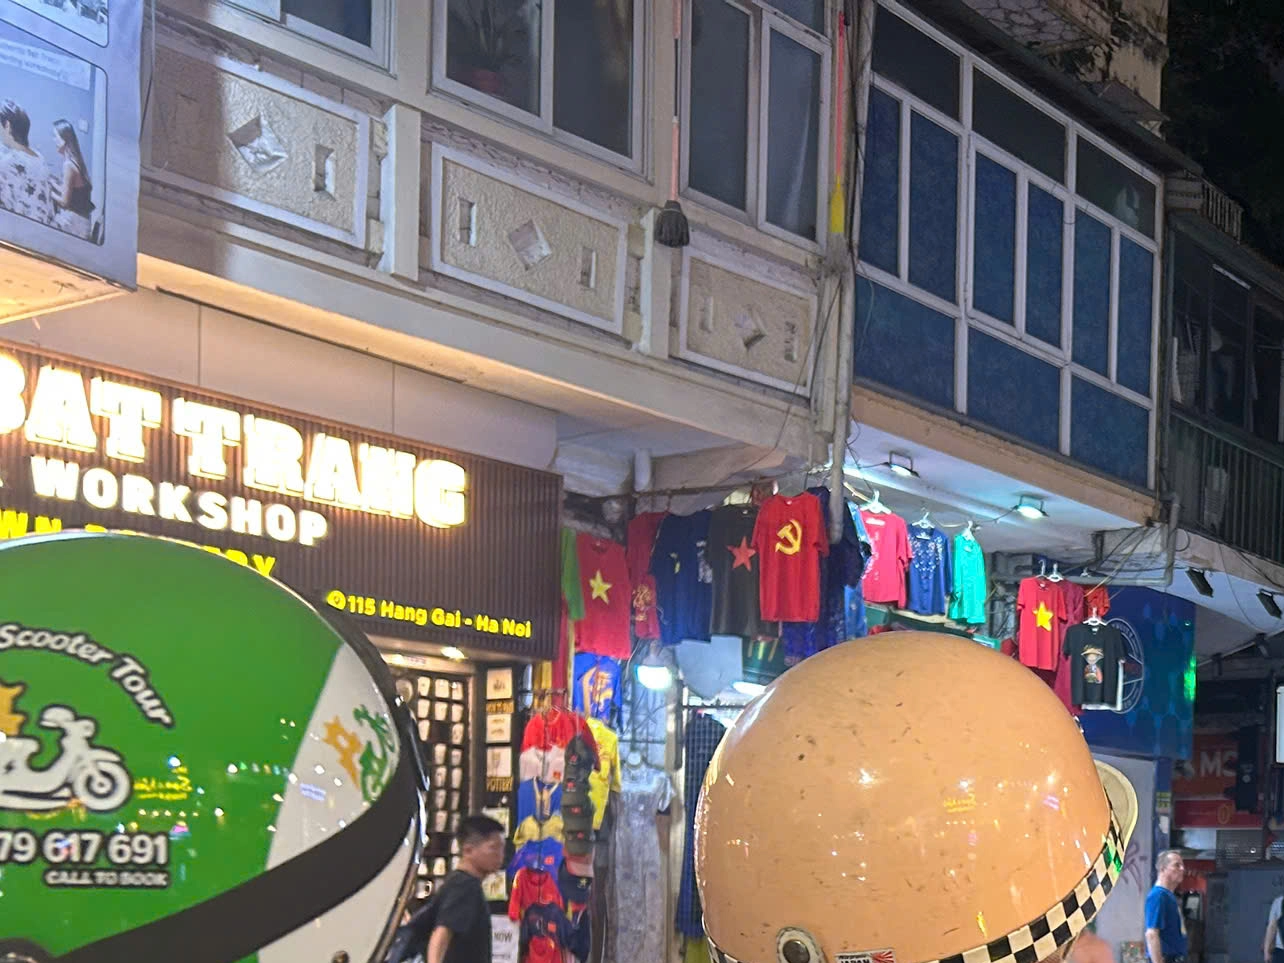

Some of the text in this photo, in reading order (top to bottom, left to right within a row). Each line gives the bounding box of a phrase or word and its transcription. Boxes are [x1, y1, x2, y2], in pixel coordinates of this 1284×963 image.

[172, 397, 467, 528] TRANG
[30, 455, 328, 546] WORKSHOP
[345, 595, 376, 616] 115
[380, 601, 428, 626] Hang
[431, 608, 462, 629] Gai
[476, 614, 500, 633] Ha
[502, 618, 533, 638] Noi
[0, 624, 173, 725] Scooter Tour
[43, 831, 101, 865] 617
[107, 833, 169, 866] 691
[44, 871, 93, 886] CALL
